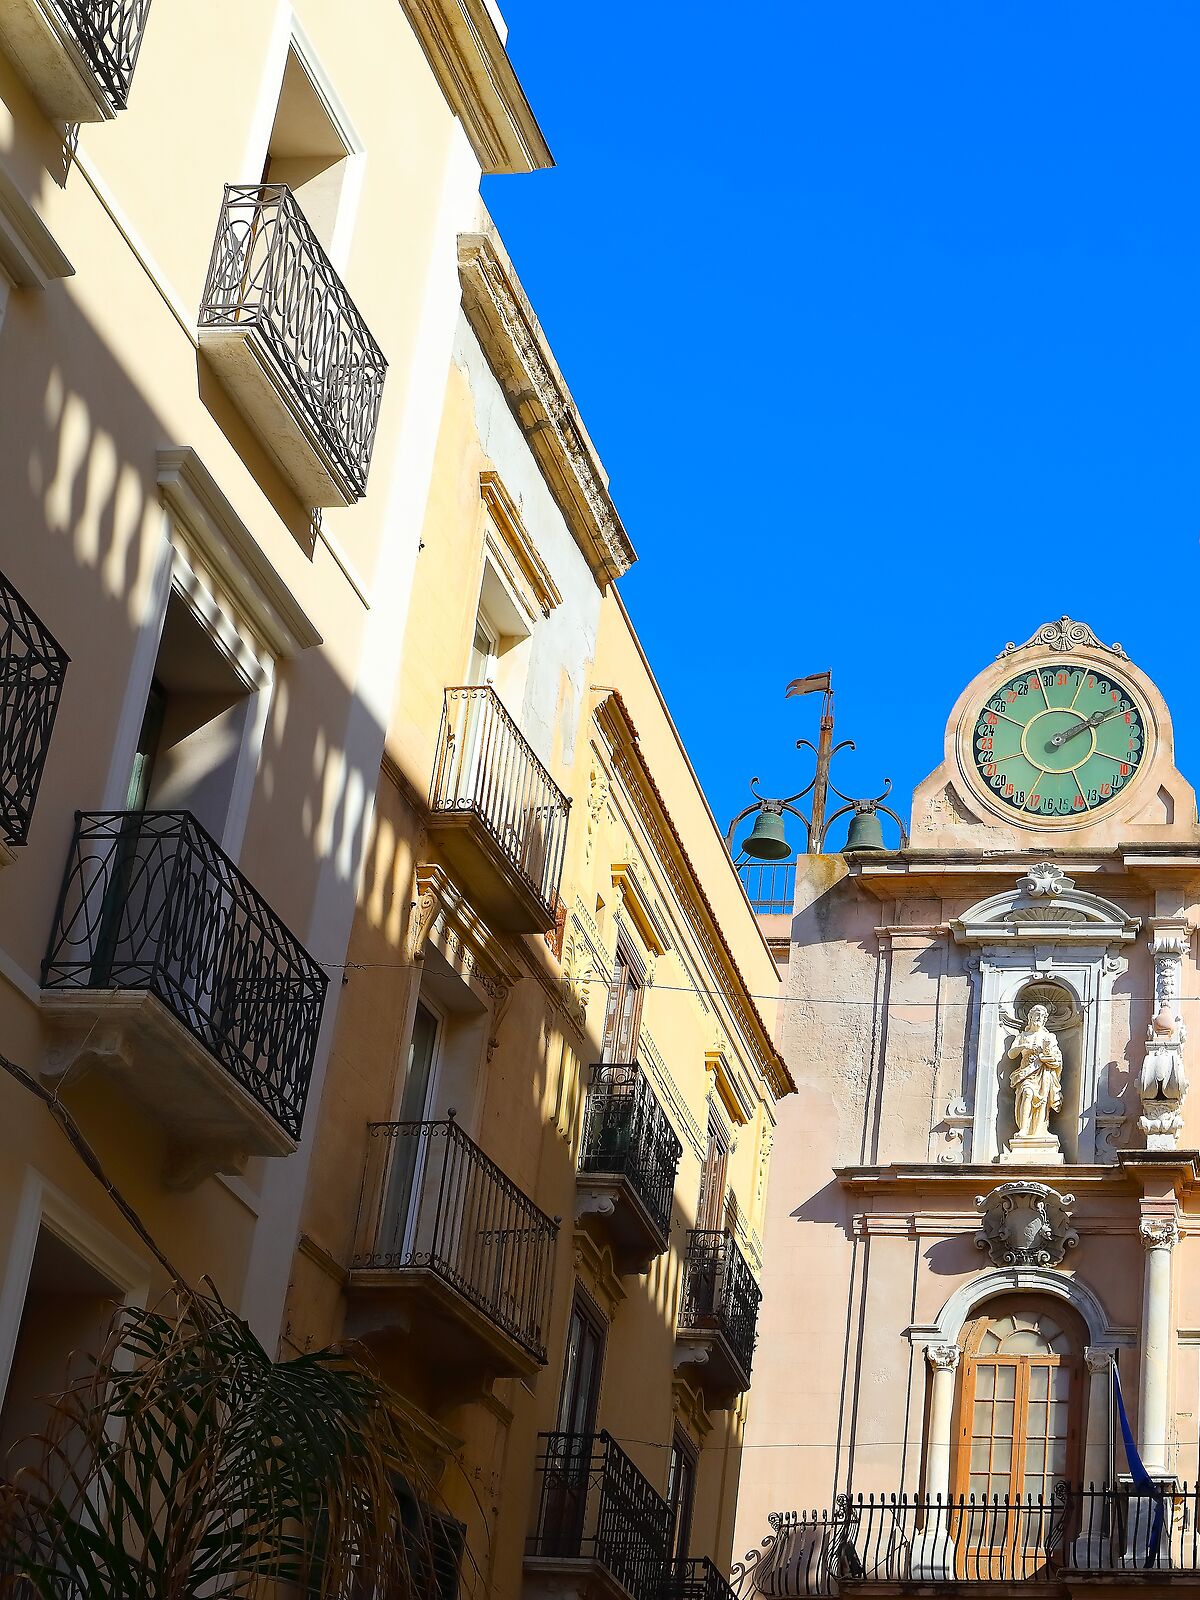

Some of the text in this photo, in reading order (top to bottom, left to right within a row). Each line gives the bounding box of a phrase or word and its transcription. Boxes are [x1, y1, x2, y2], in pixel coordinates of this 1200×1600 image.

[1044, 675, 1054, 687] 30
[1057, 673, 1067, 686] 31
[1075, 674, 1080, 687] 1
[1088, 676, 1094, 688] 2
[1018, 683, 1029, 695] 28
[1100, 682, 1107, 694] 3
[1007, 691, 1018, 703] 27
[1111, 691, 1117, 704] 4
[995, 700, 1006, 713] 26
[1119, 701, 1125, 712] 5
[987, 713, 998, 725] 25
[1125, 712, 1131, 724] 6
[983, 724, 995, 737] 24
[1129, 725, 1135, 737] 7
[981, 738, 993, 750] 23
[982, 751, 994, 762] 22
[1126, 752, 1132, 762] 9
[986, 764, 997, 776] 21
[1119, 763, 1129, 776] 10
[995, 774, 1007, 786] 20
[1112, 774, 1119, 787] 11
[1004, 783, 1014, 795] 19
[1087, 789, 1098, 801] 13
[1100, 783, 1110, 795] 12
[1015, 791, 1025, 803] 18
[1030, 795, 1041, 807] 17
[1073, 795, 1083, 807] 14
[1043, 798, 1054, 810] 16
[1059, 798, 1069, 810] 15
